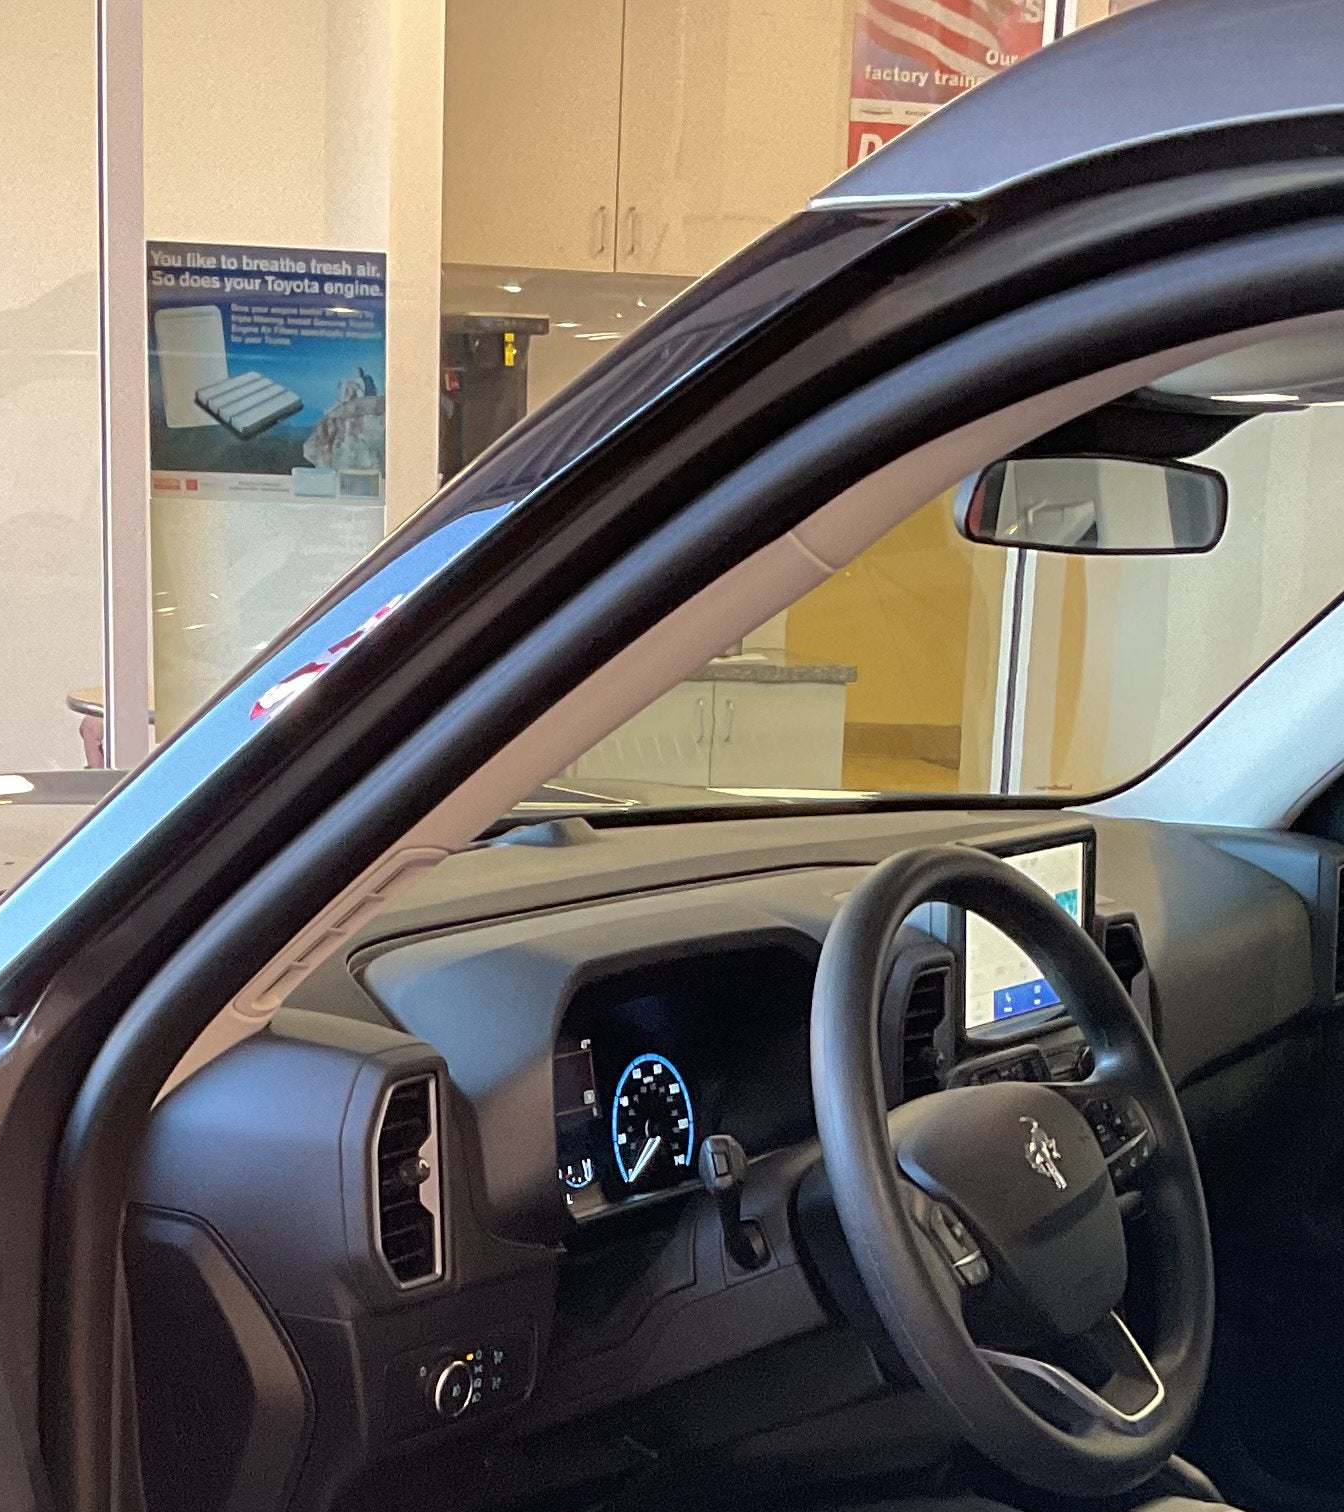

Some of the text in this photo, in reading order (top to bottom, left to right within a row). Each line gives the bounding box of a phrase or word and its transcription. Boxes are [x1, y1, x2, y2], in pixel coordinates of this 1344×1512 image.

[865, 64, 929, 87] factory
[151, 250, 381, 278] You like to breathe fresh air.
[152, 270, 384, 299] So does your Toyota engine.
